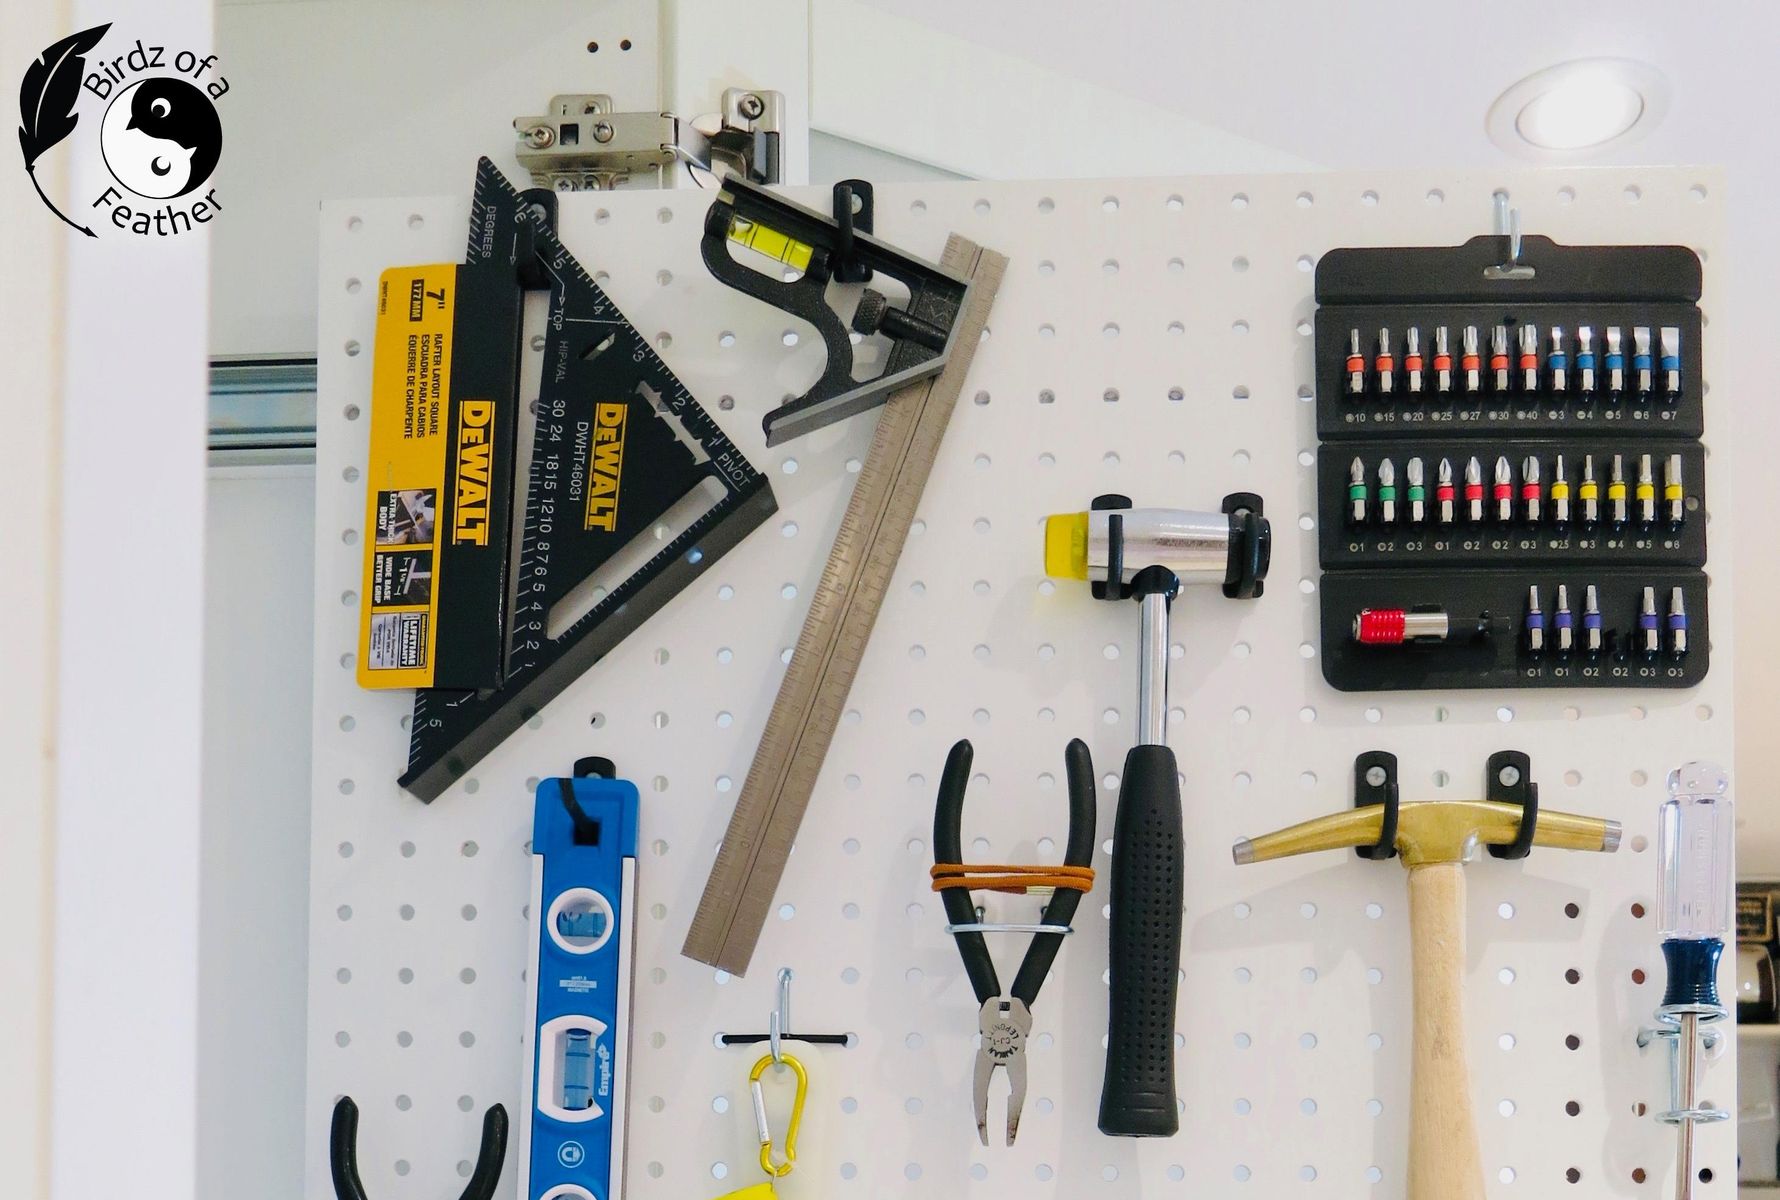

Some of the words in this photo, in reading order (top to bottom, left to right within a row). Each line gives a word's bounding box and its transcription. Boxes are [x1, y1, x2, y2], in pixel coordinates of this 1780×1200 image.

[482, 206, 496, 258] DEGREES
[553, 308, 564, 331] TOP
[553, 257, 567, 270] 5
[593, 305, 605, 315] 4
[632, 351, 645, 362] 3
[672, 397, 686, 411] 2
[419, 334, 430, 380] ESCUADRA
[433, 333, 443, 366] RAFTER
[555, 340, 569, 384] HIP-VAL
[406, 375, 415, 387] DE
[431, 368, 441, 399] LAYOUT
[418, 381, 428, 405] PARA
[404, 388, 415, 439] CHARPENTE
[429, 400, 439, 436] SQUARE
[552, 400, 566, 418] 30
[1354, 413, 1366, 422] 10
[1383, 412, 1395, 422] 15
[1412, 412, 1424, 421] 20
[1440, 411, 1453, 421] 25
[1469, 411, 1481, 421] 27
[1497, 411, 1510, 420] 30
[1526, 410, 1538, 420] 40
[1558, 410, 1565, 420] 3
[1586, 410, 1593, 420] 4
[1615, 410, 1621, 420] 5
[1643, 410, 1650, 420] 6
[1670, 411, 1677, 420] 7
[416, 406, 426, 438] CABIOS
[549, 425, 563, 442] 24
[546, 453, 559, 469] 18
[568, 421, 589, 501] DWHT46031
[717, 452, 751, 487] PIVOT
[543, 474, 557, 490] 15
[389, 493, 397, 519] EXTRA
[540, 498, 555, 514] 12
[378, 506, 387, 531] BODY
[539, 517, 553, 533] 10
[537, 541, 550, 551] 8
[1359, 542, 1365, 552] 1
[1387, 542, 1394, 551] 2
[1416, 541, 1423, 551] 3
[1445, 541, 1450, 550] 1
[1473, 541, 1480, 550] 2
[1502, 540, 1509, 550] 2
[1530, 540, 1537, 549] 3
[1589, 540, 1596, 549] 3
[1617, 540, 1624, 549] 4
[1645, 540, 1652, 549] 5
[375, 554, 384, 584] BETTER
[384, 556, 393, 578] WIDE
[535, 554, 549, 564] 7
[534, 566, 548, 576] 6
[374, 586, 382, 604] GRIP
[383, 580, 392, 601] BASE
[532, 582, 546, 592] 5
[531, 601, 543, 612] 4
[528, 621, 542, 631] 3
[401, 620, 410, 665] WARRANTY
[407, 620, 418, 665] LIFETIME
[526, 640, 540, 650] 2
[1537, 668, 1542, 677] 1
[1564, 668, 1569, 676] 1
[1593, 667, 1599, 677] 2
[1622, 667, 1628, 677] 2
[1650, 667, 1656, 677] 3
[1677, 668, 1684, 677] 3
[993, 1037, 1011, 1046] CJ-1
